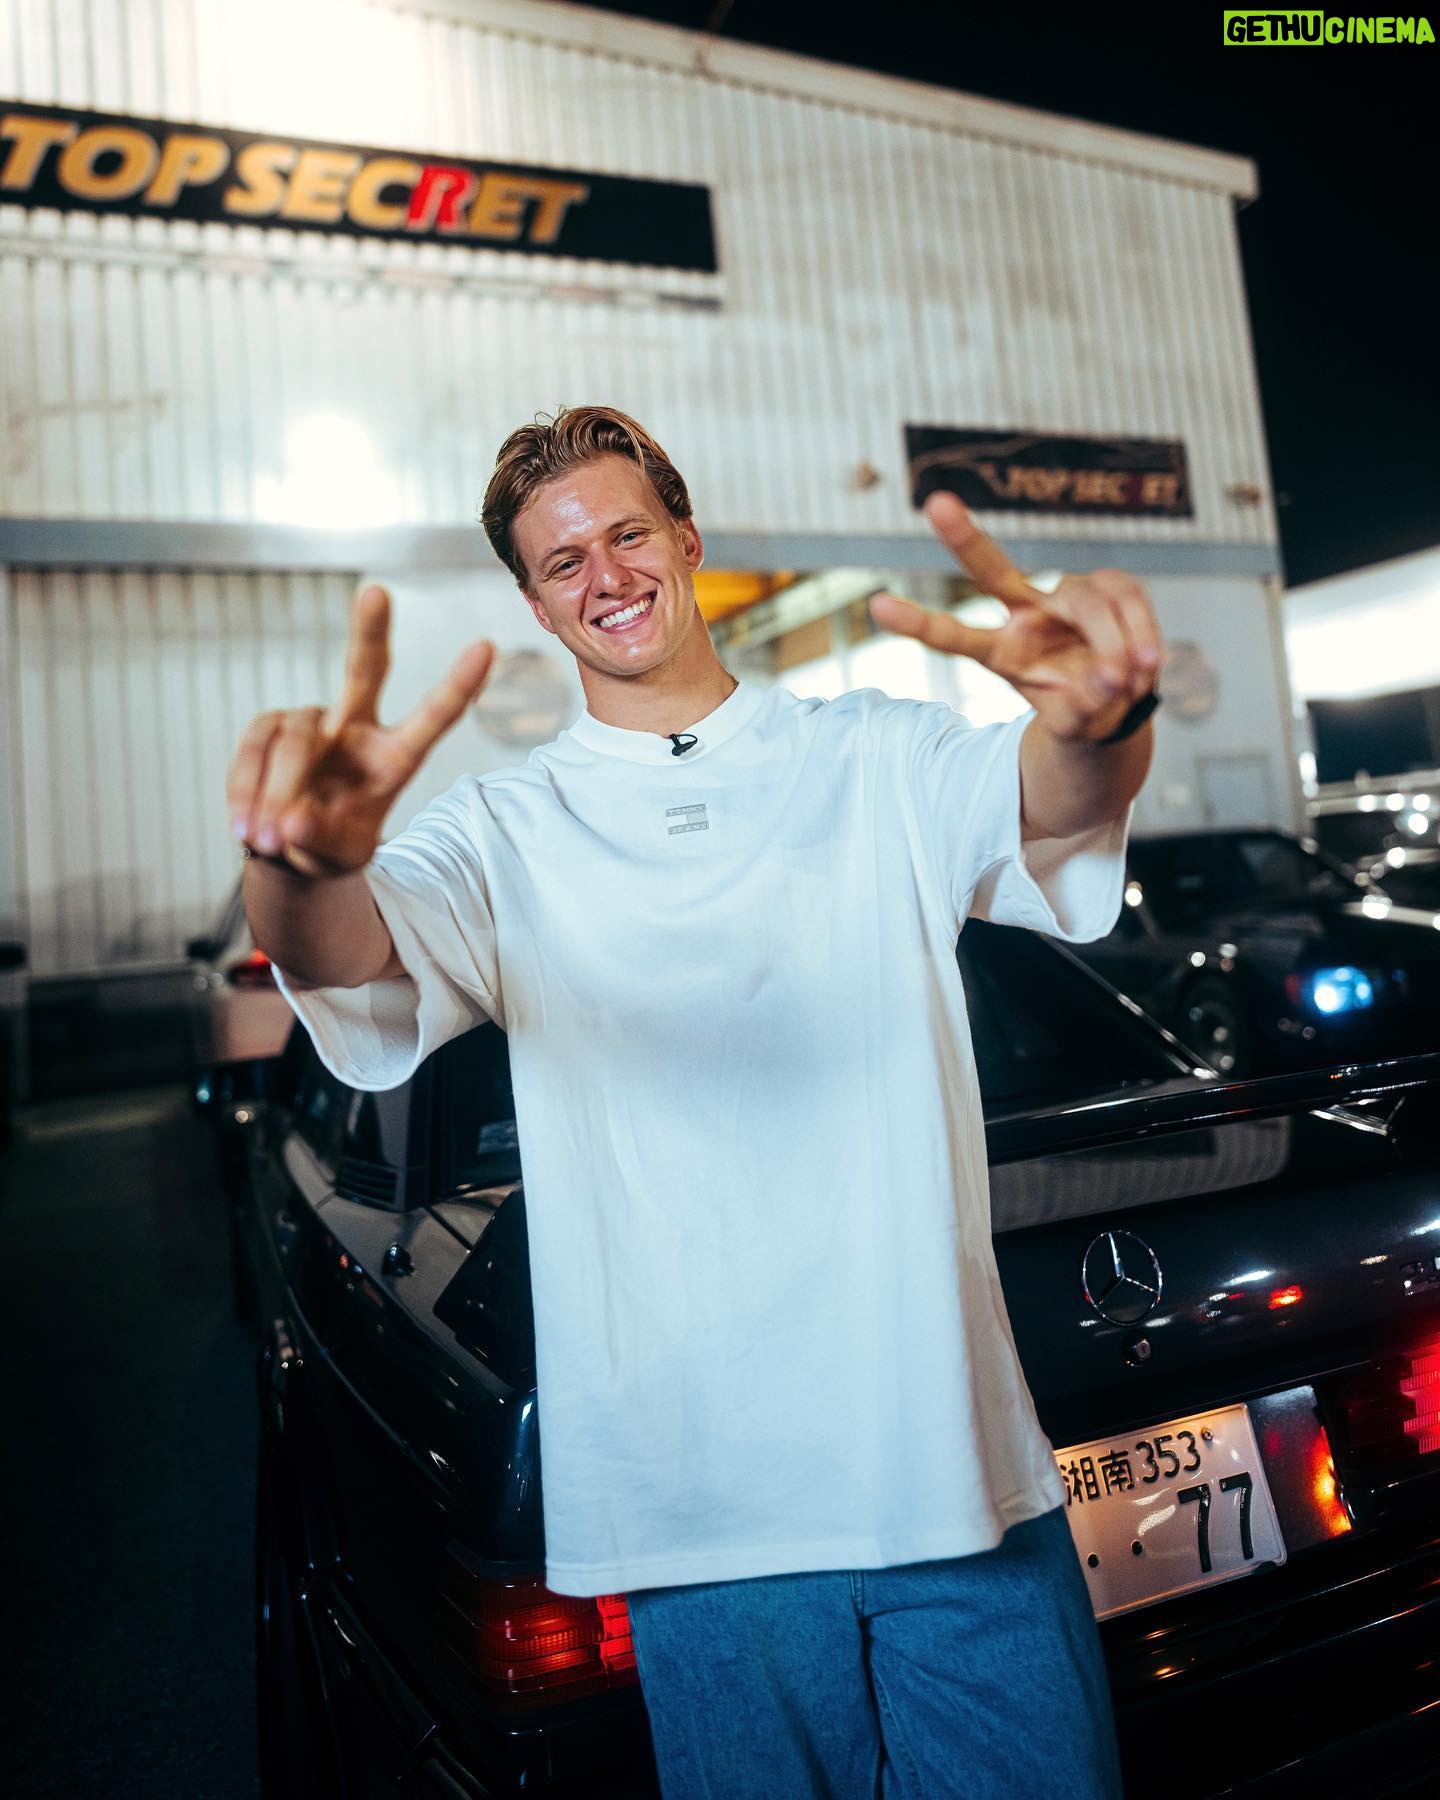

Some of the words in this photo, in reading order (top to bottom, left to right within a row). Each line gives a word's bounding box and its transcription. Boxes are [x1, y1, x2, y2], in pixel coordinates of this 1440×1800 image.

[1, 117, 227, 206] TOP
[227, 143, 589, 243] SECRET
[1060, 1450, 1135, 1506] 湘南
[1135, 1430, 1202, 1484] 353
